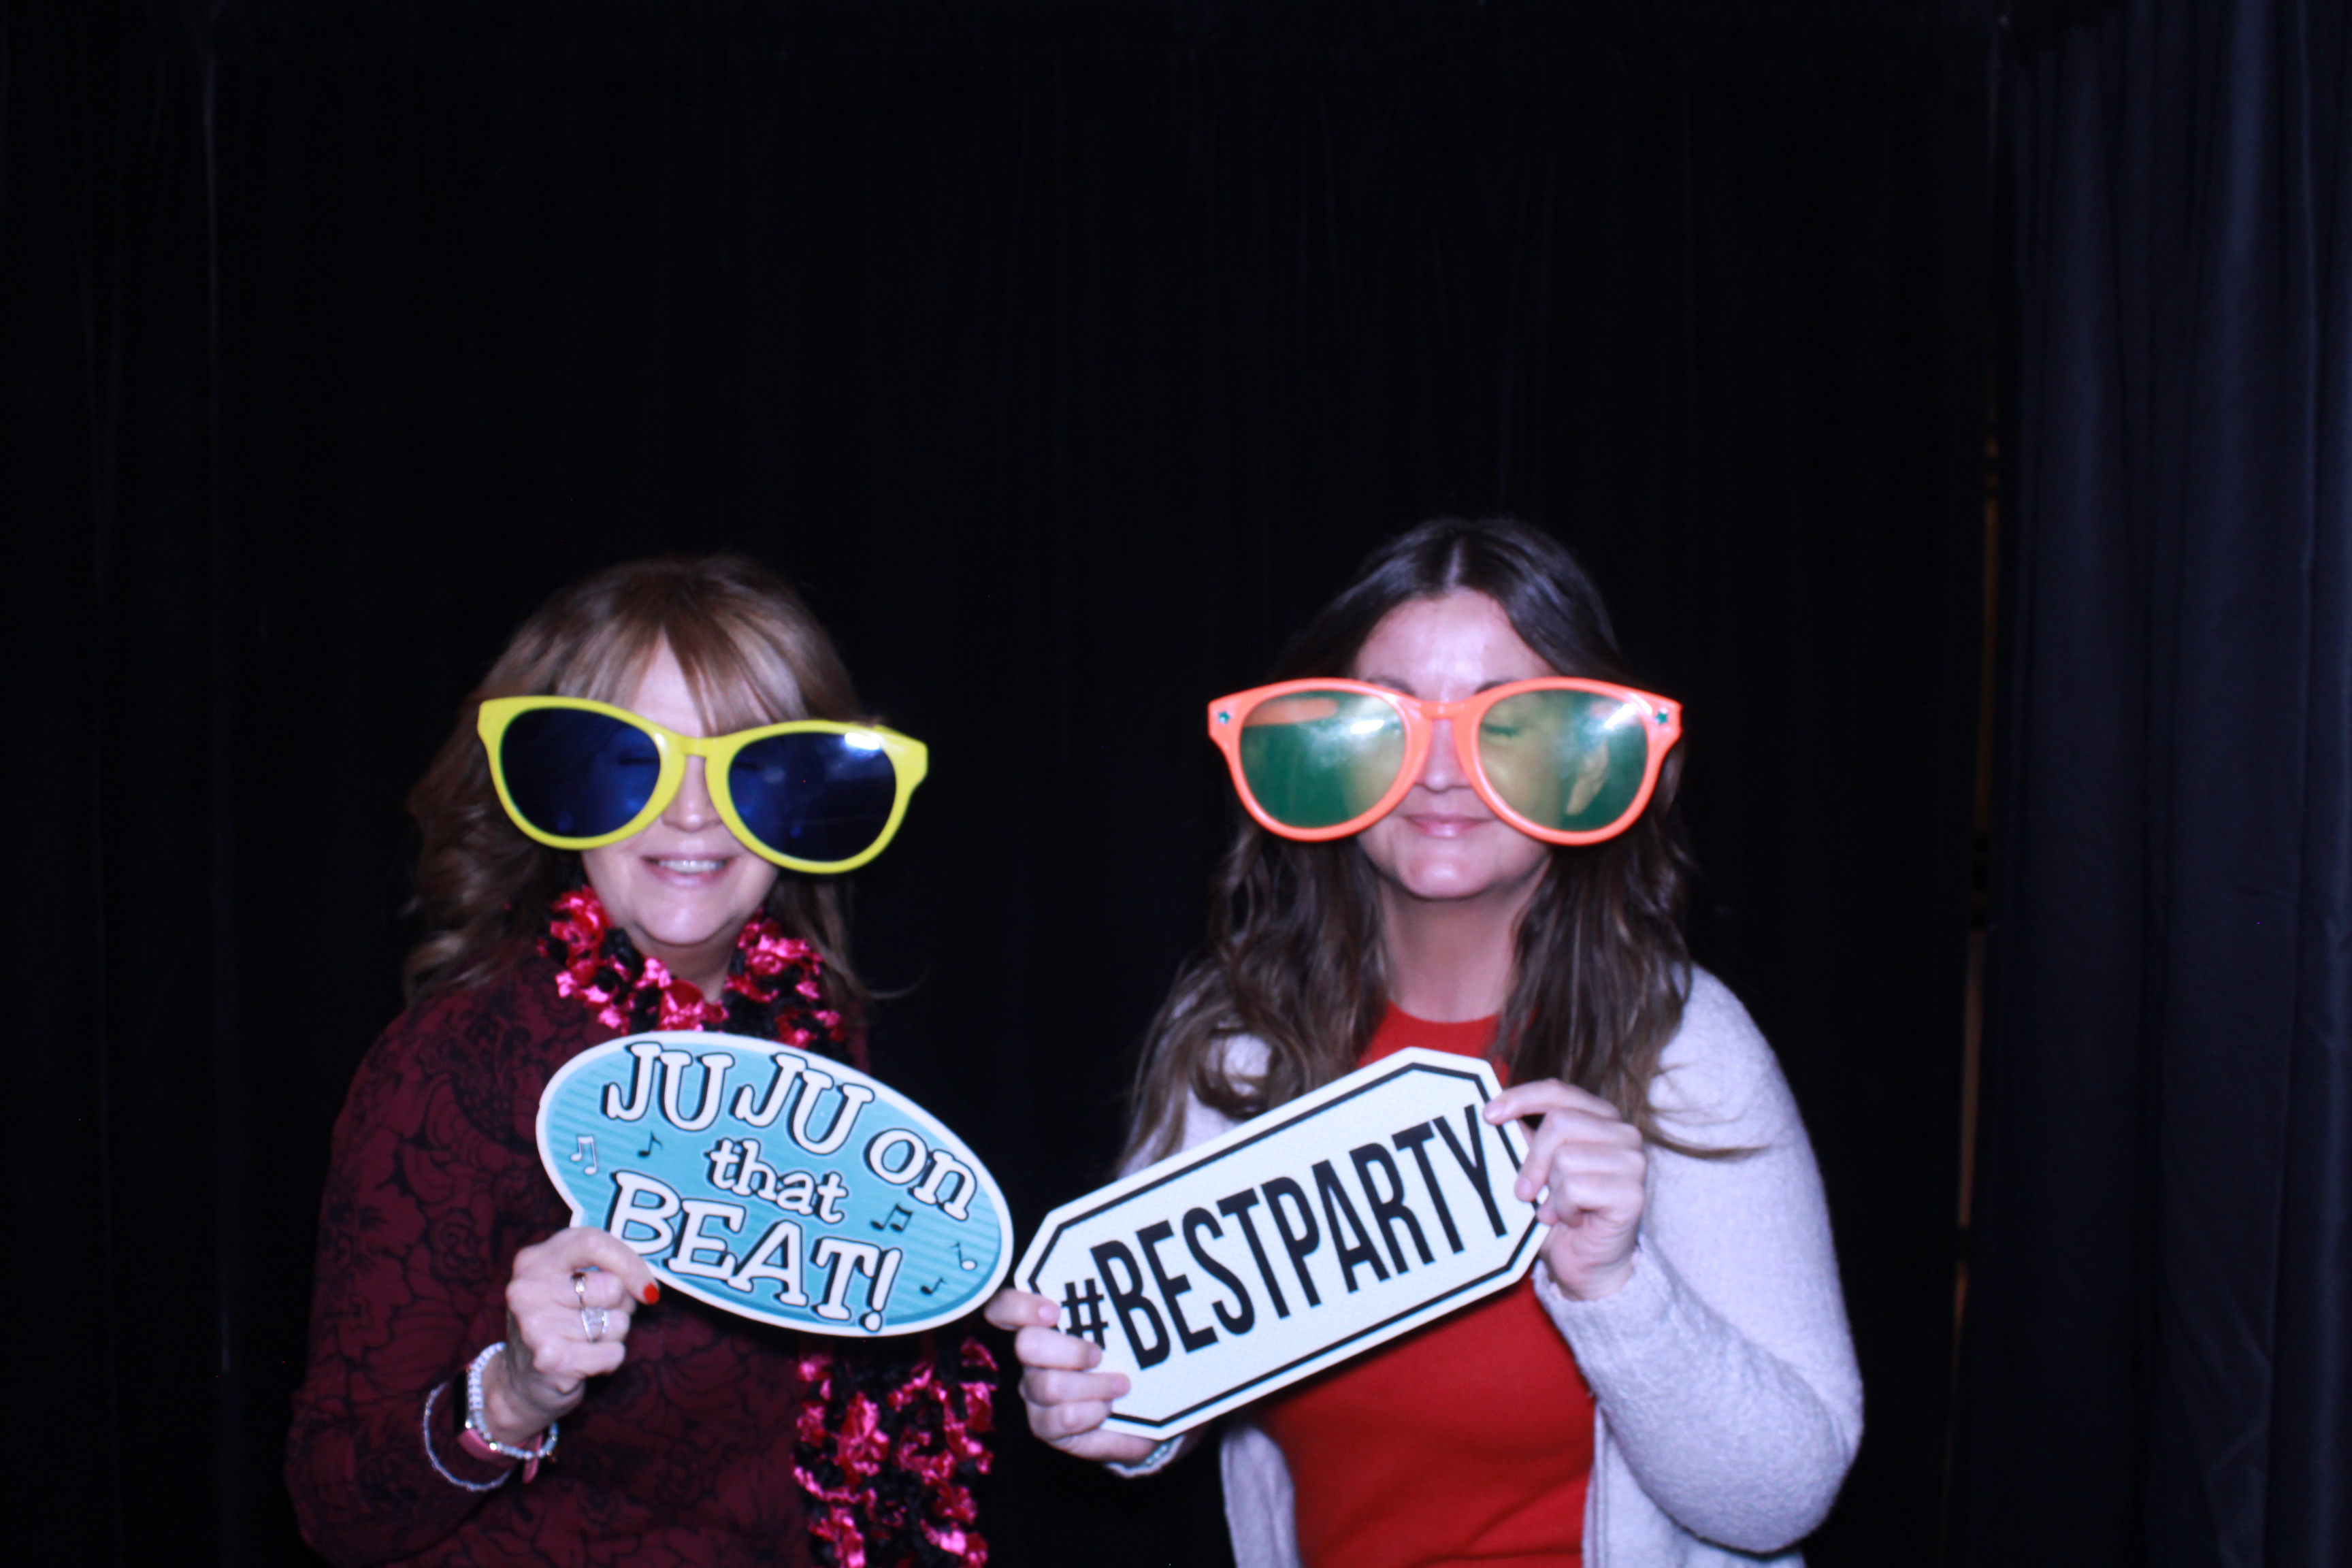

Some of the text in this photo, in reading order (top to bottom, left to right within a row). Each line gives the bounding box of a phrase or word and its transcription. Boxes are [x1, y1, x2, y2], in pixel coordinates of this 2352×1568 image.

[706, 1138, 849, 1224] that
[865, 1128, 978, 1221] on
[1061, 1104, 1507, 1371] #BESTPARTY
[605, 1170, 903, 1333] BEAT!
